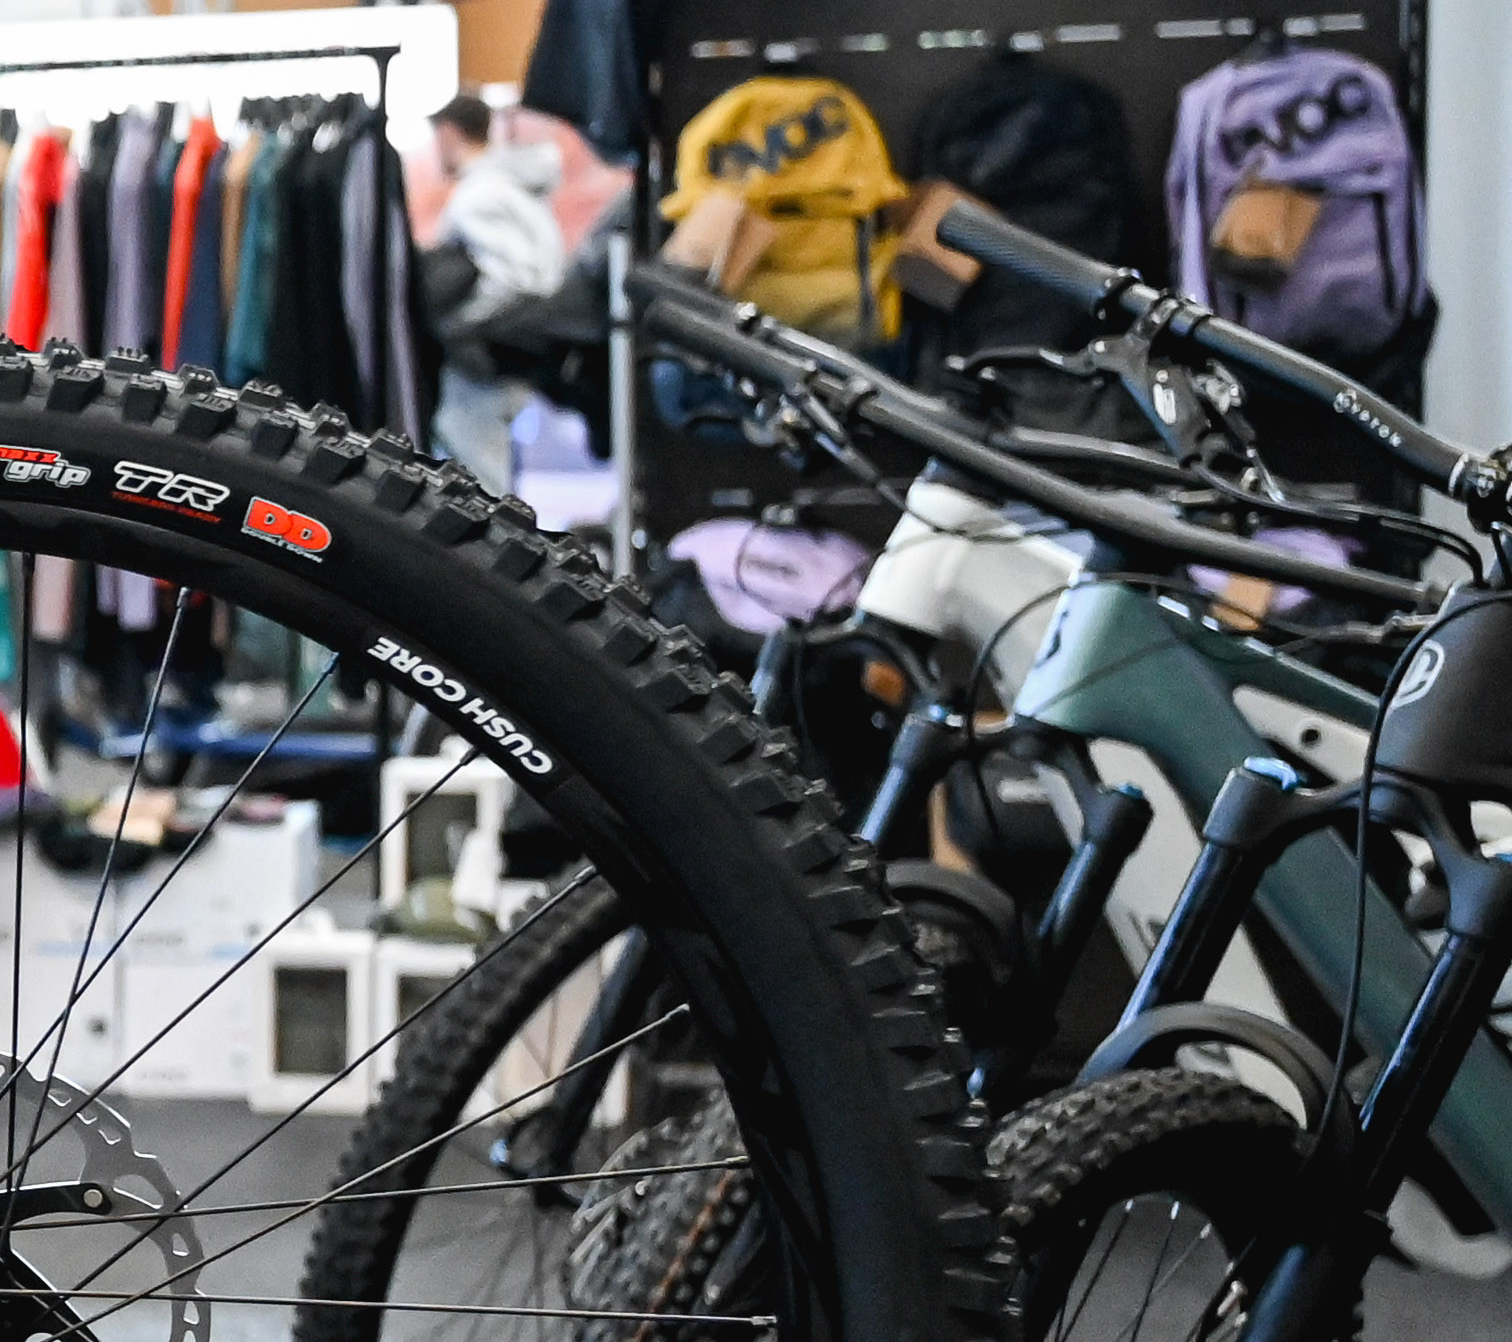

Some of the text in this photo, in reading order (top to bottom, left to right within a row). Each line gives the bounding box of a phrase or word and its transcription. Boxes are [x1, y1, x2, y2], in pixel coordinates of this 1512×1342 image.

[112, 459, 231, 513] TR
[243, 496, 332, 553] DD
[366, 636, 554, 775] CUSH CORE
